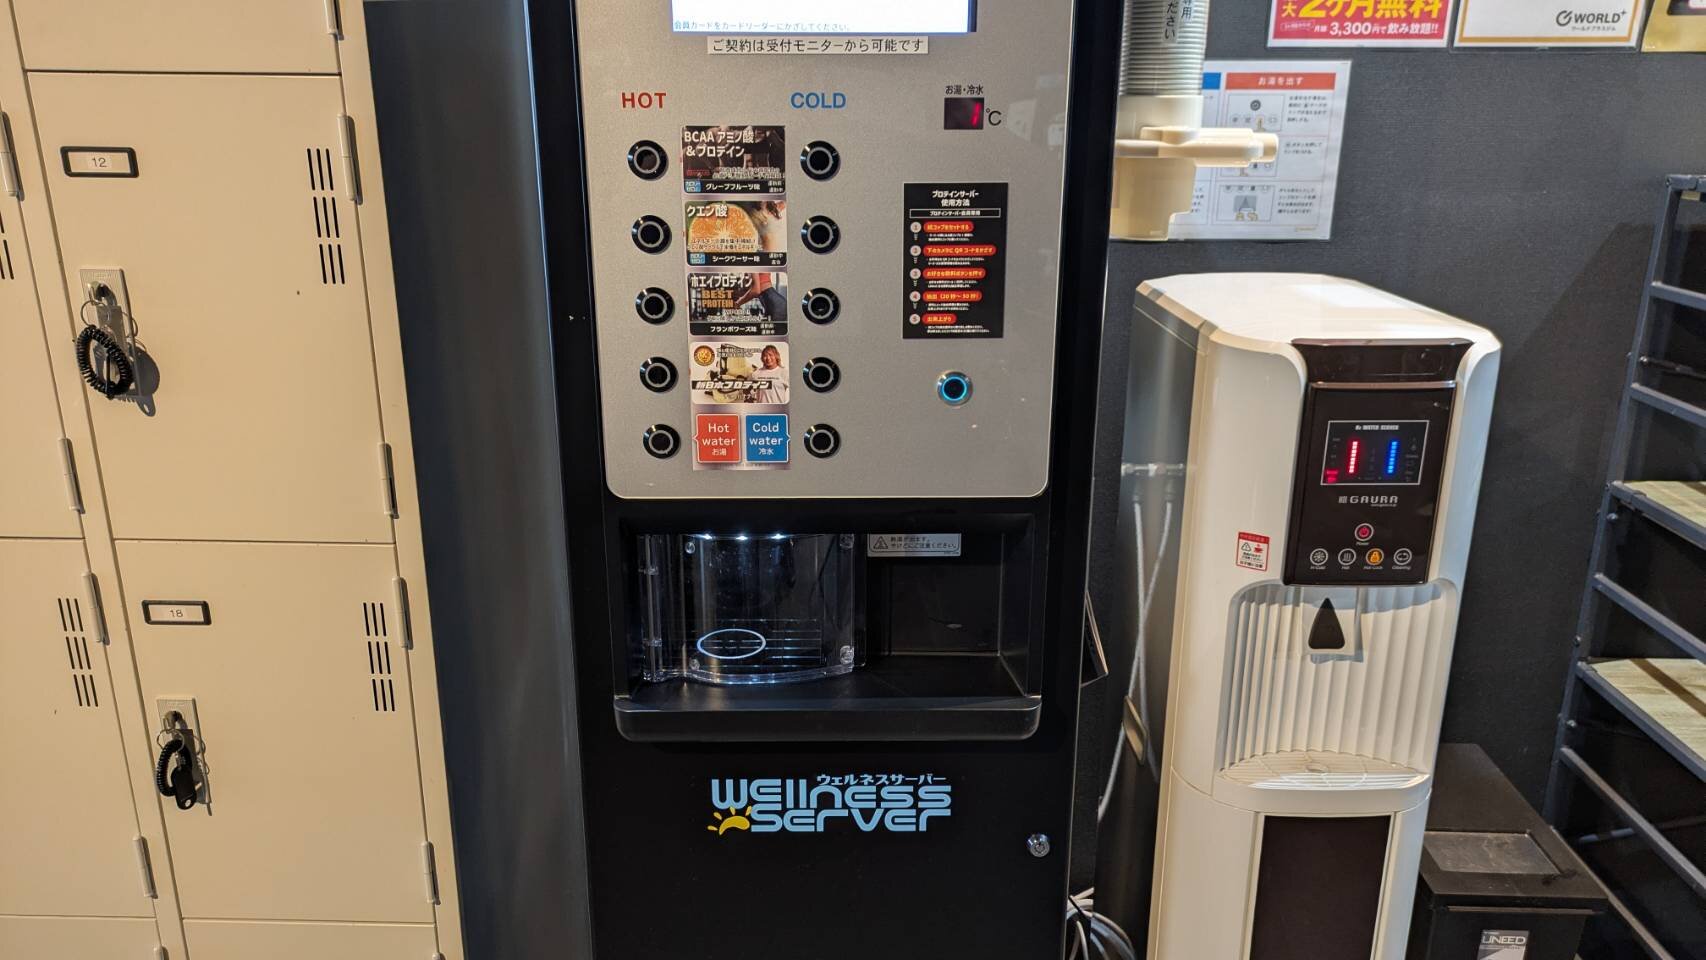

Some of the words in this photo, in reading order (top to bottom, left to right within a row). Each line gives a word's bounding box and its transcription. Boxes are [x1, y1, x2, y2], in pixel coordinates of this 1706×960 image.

[712, 38, 925, 53] ご契約は受付モニターから可能です
[1258, 76, 1304, 86] お湯を出す
[945, 84, 984, 95] お湯・冷水
[621, 92, 667, 109] HOT
[790, 91, 847, 109] COLD
[684, 130, 715, 143] BCAA
[717, 130, 755, 144] アミノ酸
[92, 156, 108, 168] 12
[932, 189, 979, 198] プロテインサーバー
[941, 199, 971, 207] 使用方法
[687, 205, 729, 218] クエン酸
[691, 274, 753, 288] ホエイプロテイン
[702, 290, 734, 299] BEST
[703, 299, 734, 308] PROTEIN
[708, 422, 730, 433] Hot
[752, 422, 779, 433] Cold
[702, 437, 736, 446] water
[749, 437, 784, 446] water
[712, 448, 727, 456] お湯
[758, 448, 775, 456] 冷水
[1350, 495, 1399, 504] GAURA
[170, 609, 184, 618] 18
[816, 774, 947, 786] ウェルネスサーバー
